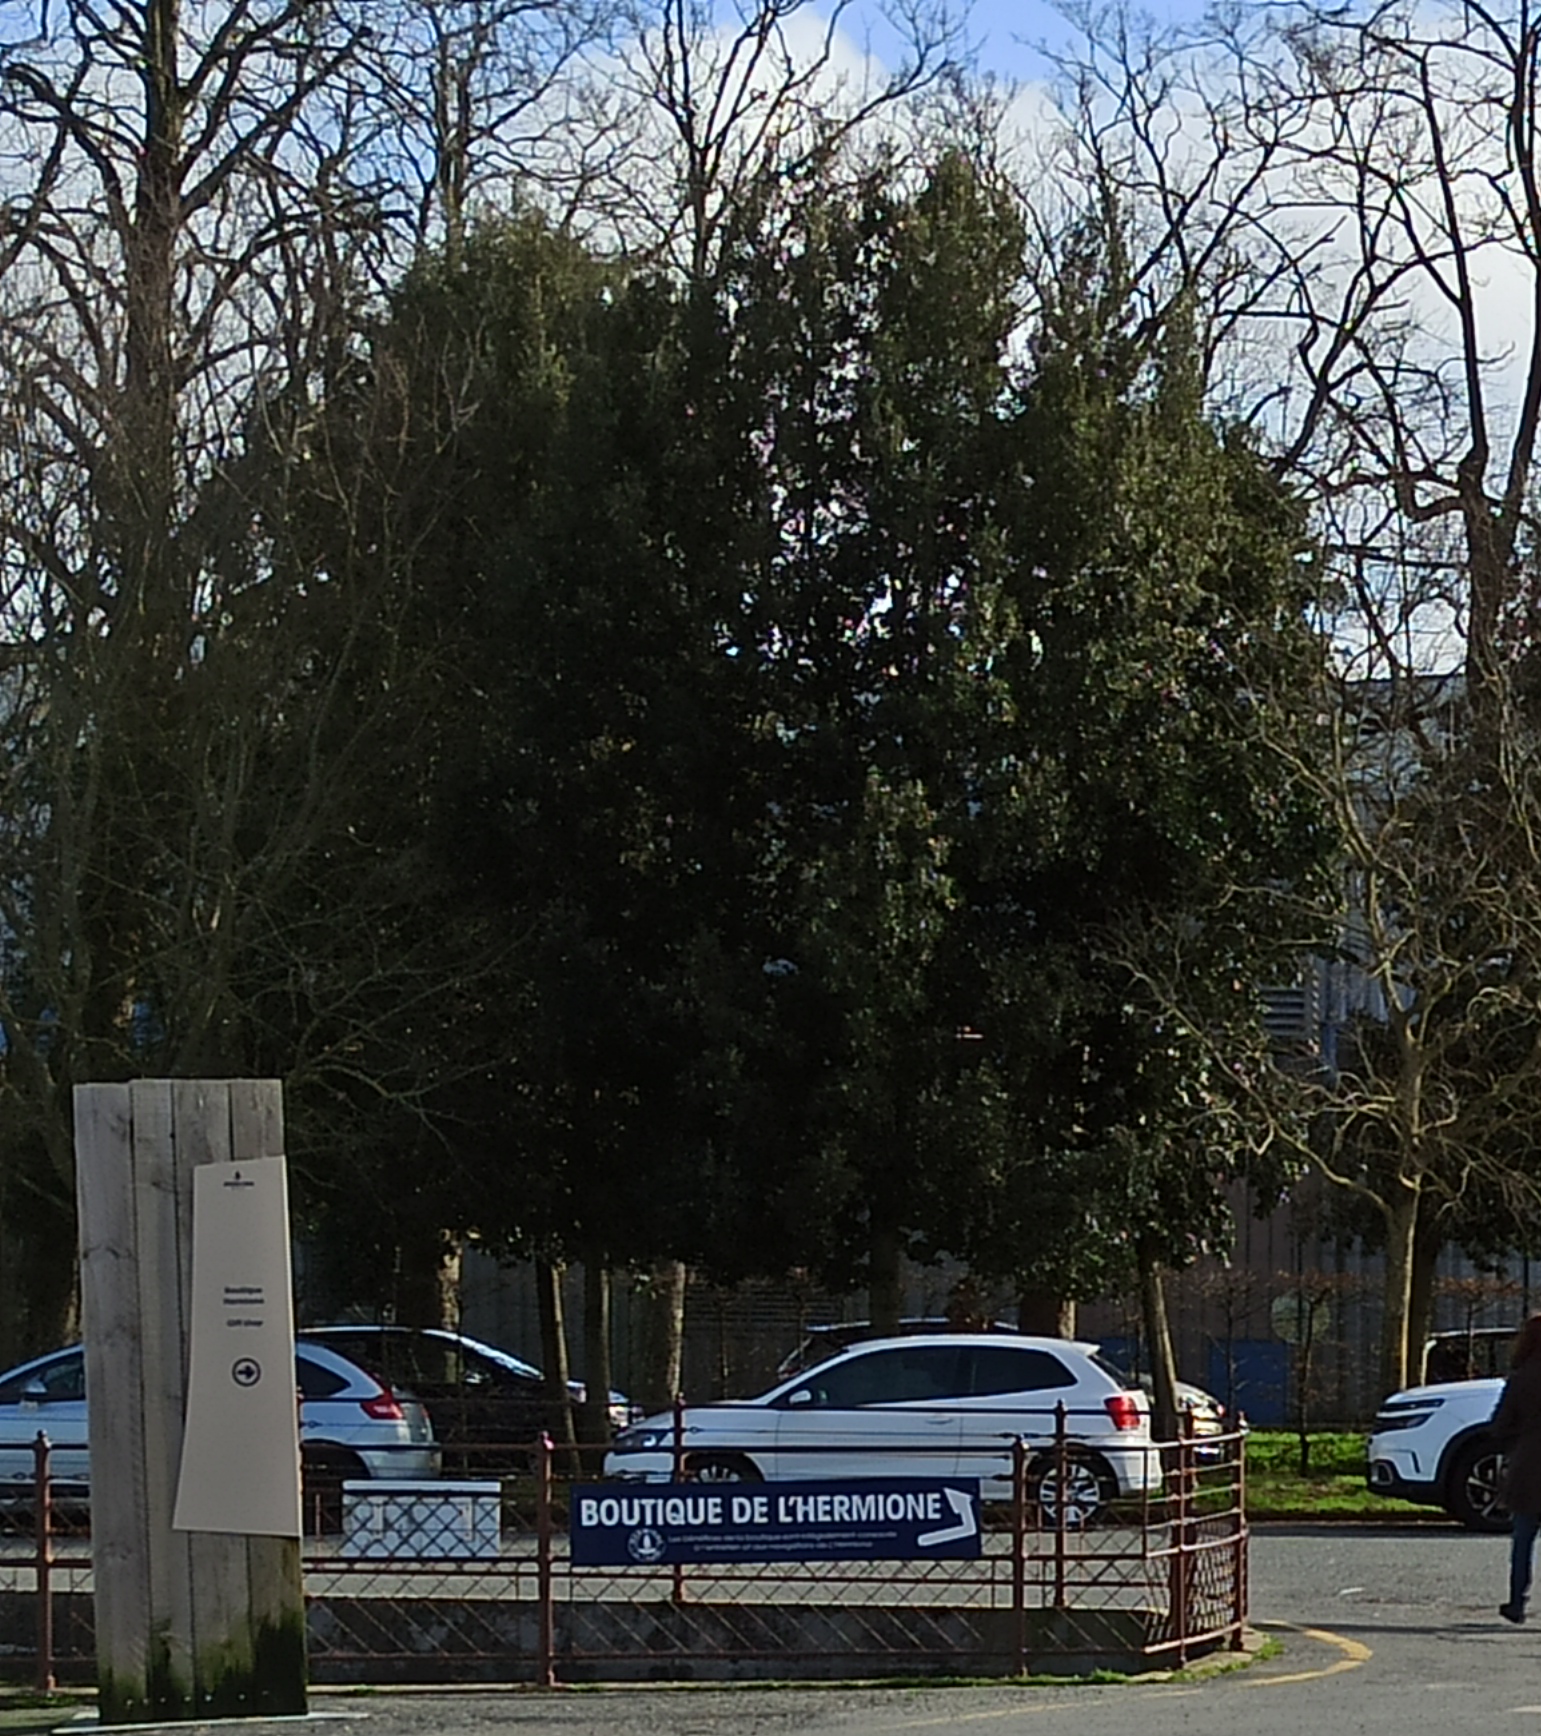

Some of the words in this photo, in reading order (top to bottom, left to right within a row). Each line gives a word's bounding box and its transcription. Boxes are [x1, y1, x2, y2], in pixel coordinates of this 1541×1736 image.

[580, 1497, 723, 1527] BOUTIQUE
[732, 1497, 769, 1524] DE
[777, 1493, 942, 1523] L'HERMIONE
